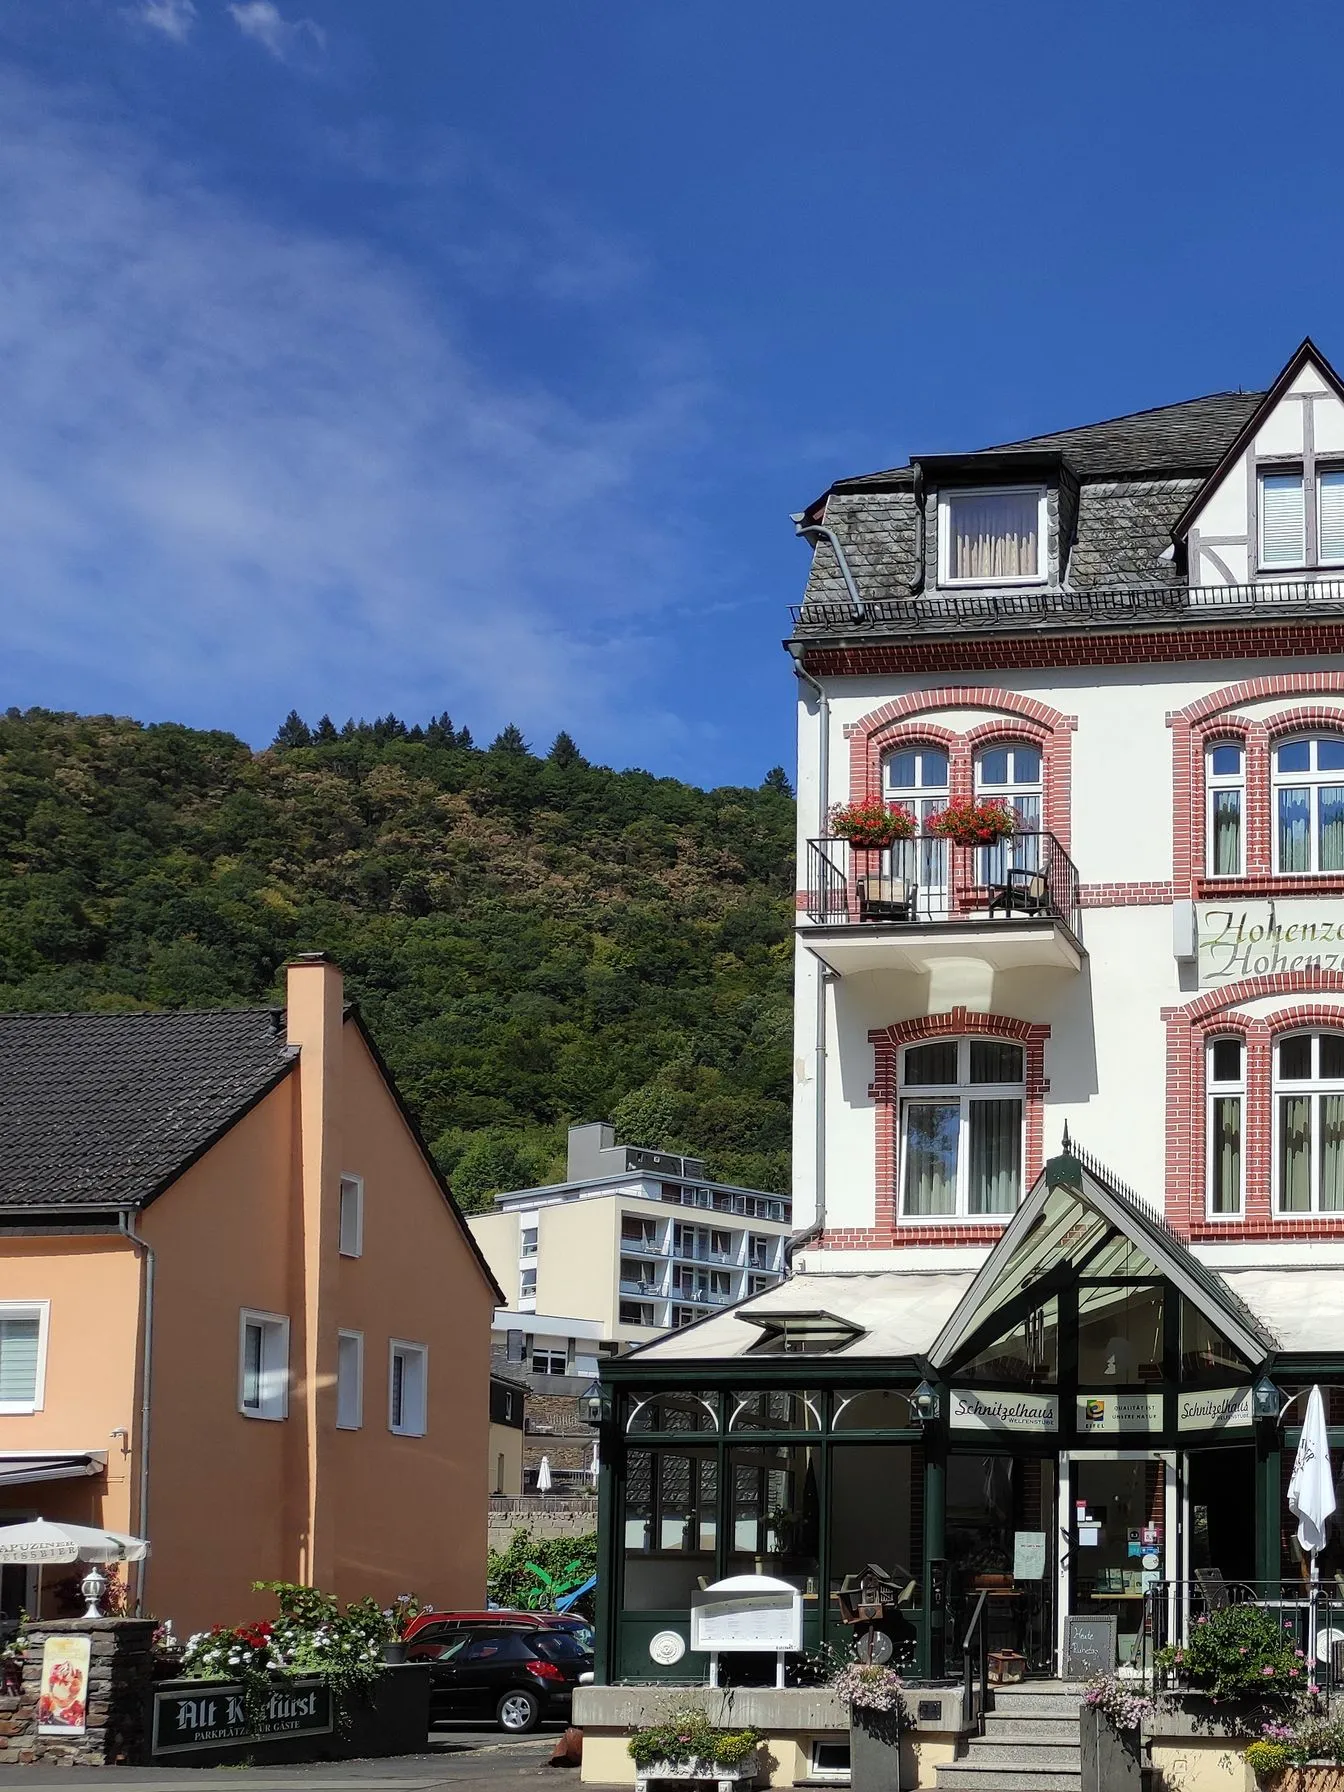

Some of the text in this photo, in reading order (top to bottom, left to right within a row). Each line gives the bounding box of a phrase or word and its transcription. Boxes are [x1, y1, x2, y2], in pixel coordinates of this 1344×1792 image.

[955, 1399, 1054, 1421] Schnitzelhaus
[1181, 1398, 1249, 1419] Schnitzelhaus
[0, 1541, 75, 1553] APUZINER
[0, 1546, 76, 1561] EISSBIER
[175, 1691, 318, 1731] Alt Kfürst
[273, 1719, 301, 1733] GÄSTE
